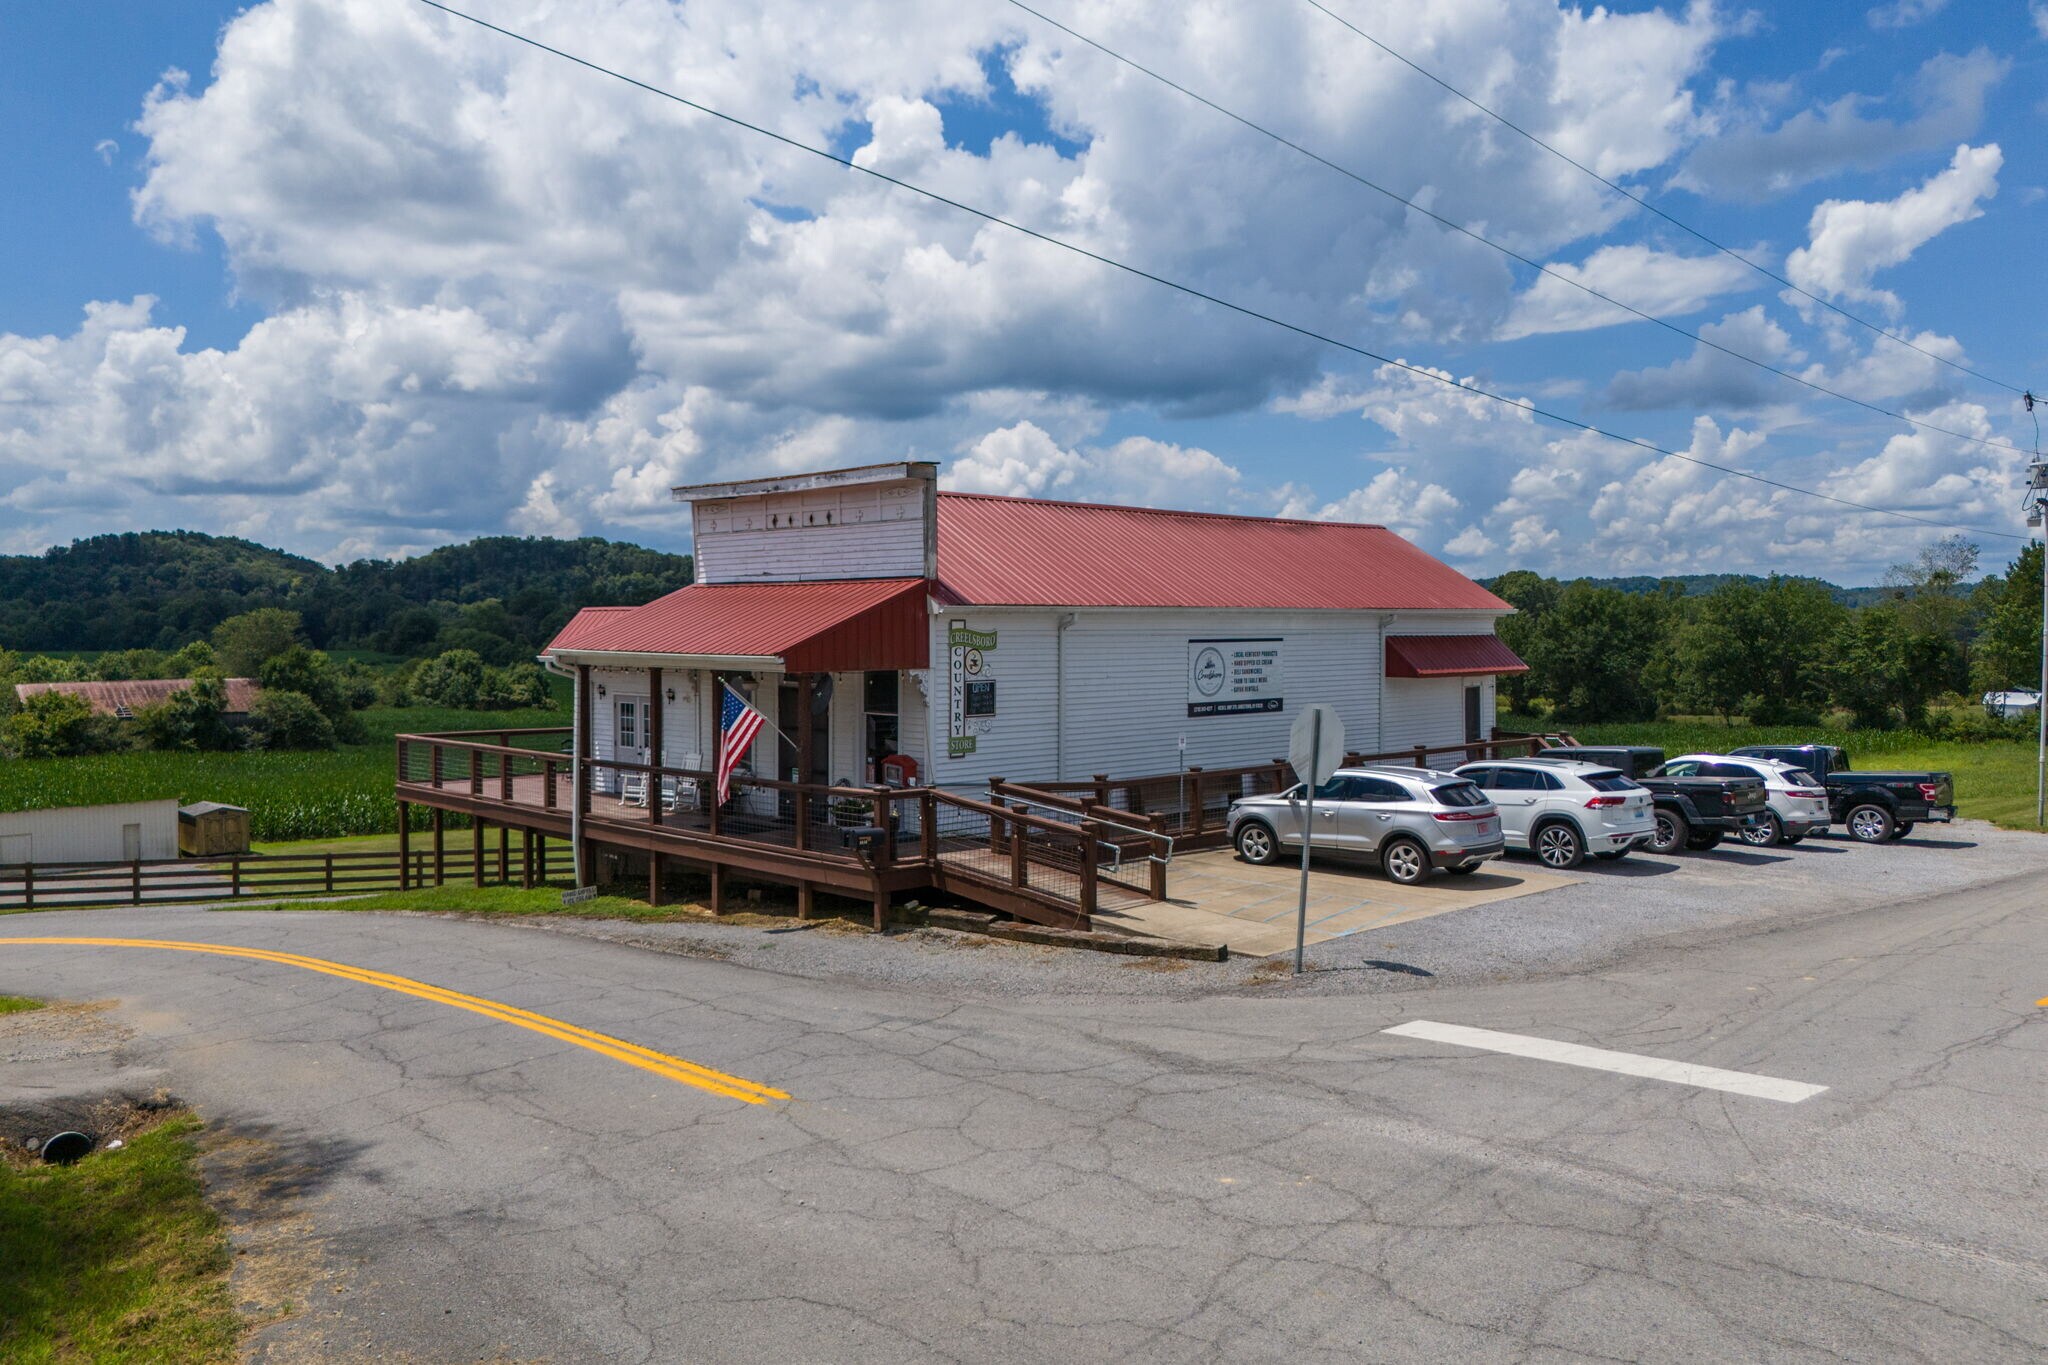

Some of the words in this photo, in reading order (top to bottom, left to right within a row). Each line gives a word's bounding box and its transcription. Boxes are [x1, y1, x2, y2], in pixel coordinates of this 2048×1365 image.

[950, 632, 996, 647] CREELSBORO
[954, 647, 962, 735] COUNTRY
[951, 739, 974, 750] STORE
